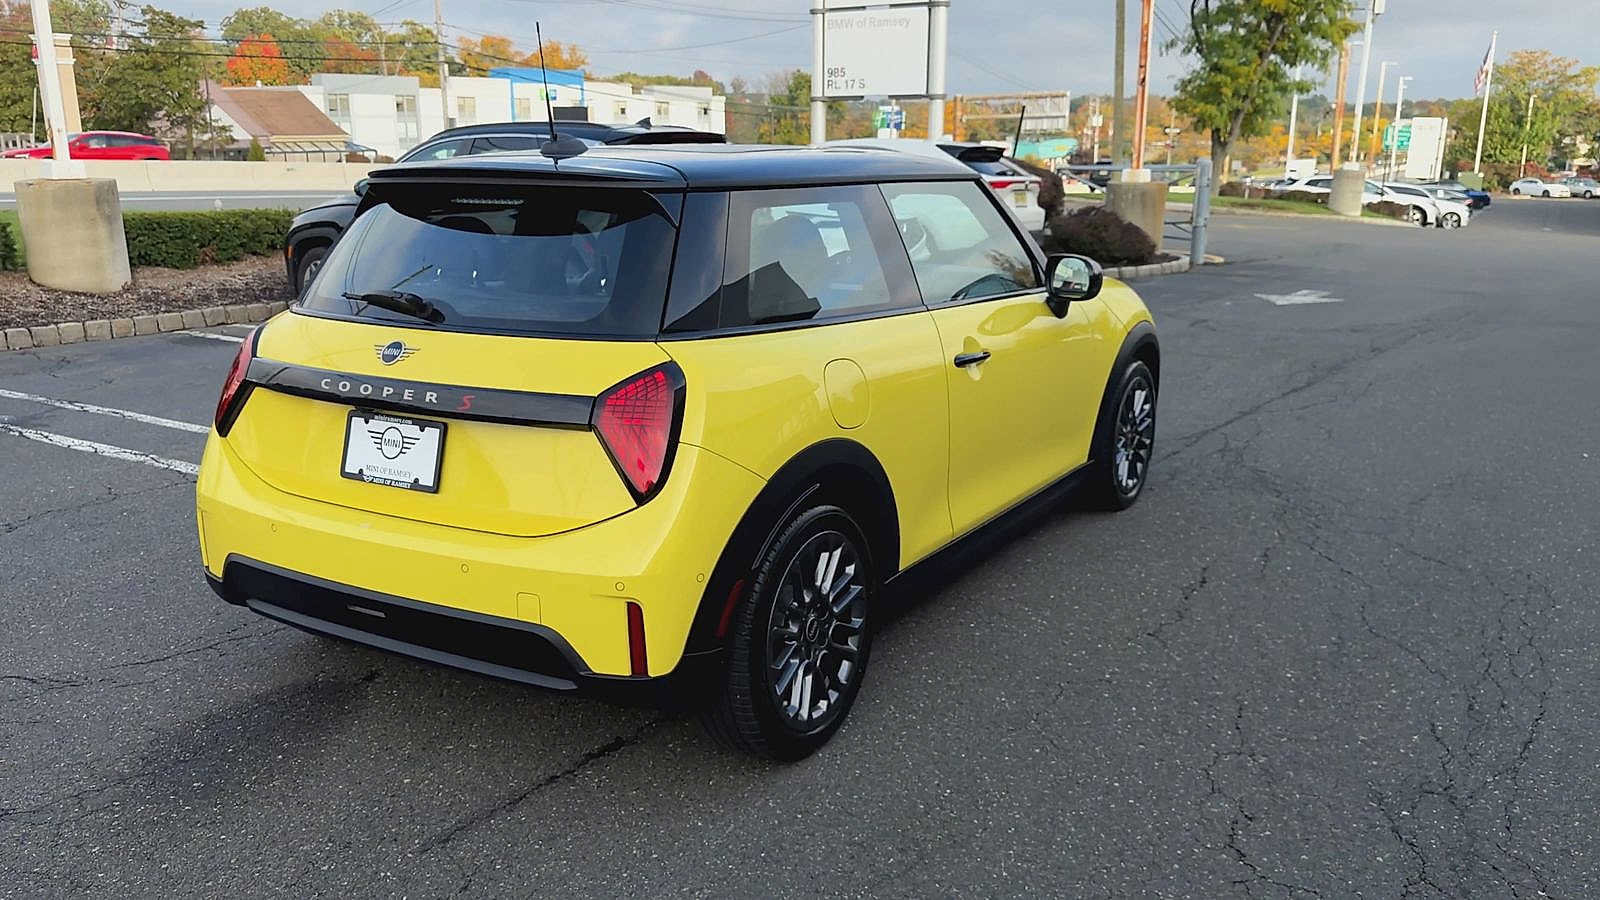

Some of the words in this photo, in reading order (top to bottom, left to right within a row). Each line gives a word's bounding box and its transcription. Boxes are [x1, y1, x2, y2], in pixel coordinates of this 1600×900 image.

[856, 17, 867, 28] of
[827, 67, 846, 78] 985
[845, 79, 855, 89] 17
[858, 78, 865, 89] S
[320, 378, 438, 404] COOPER
[456, 395, 476, 410] S
[383, 438, 401, 449] MINI
